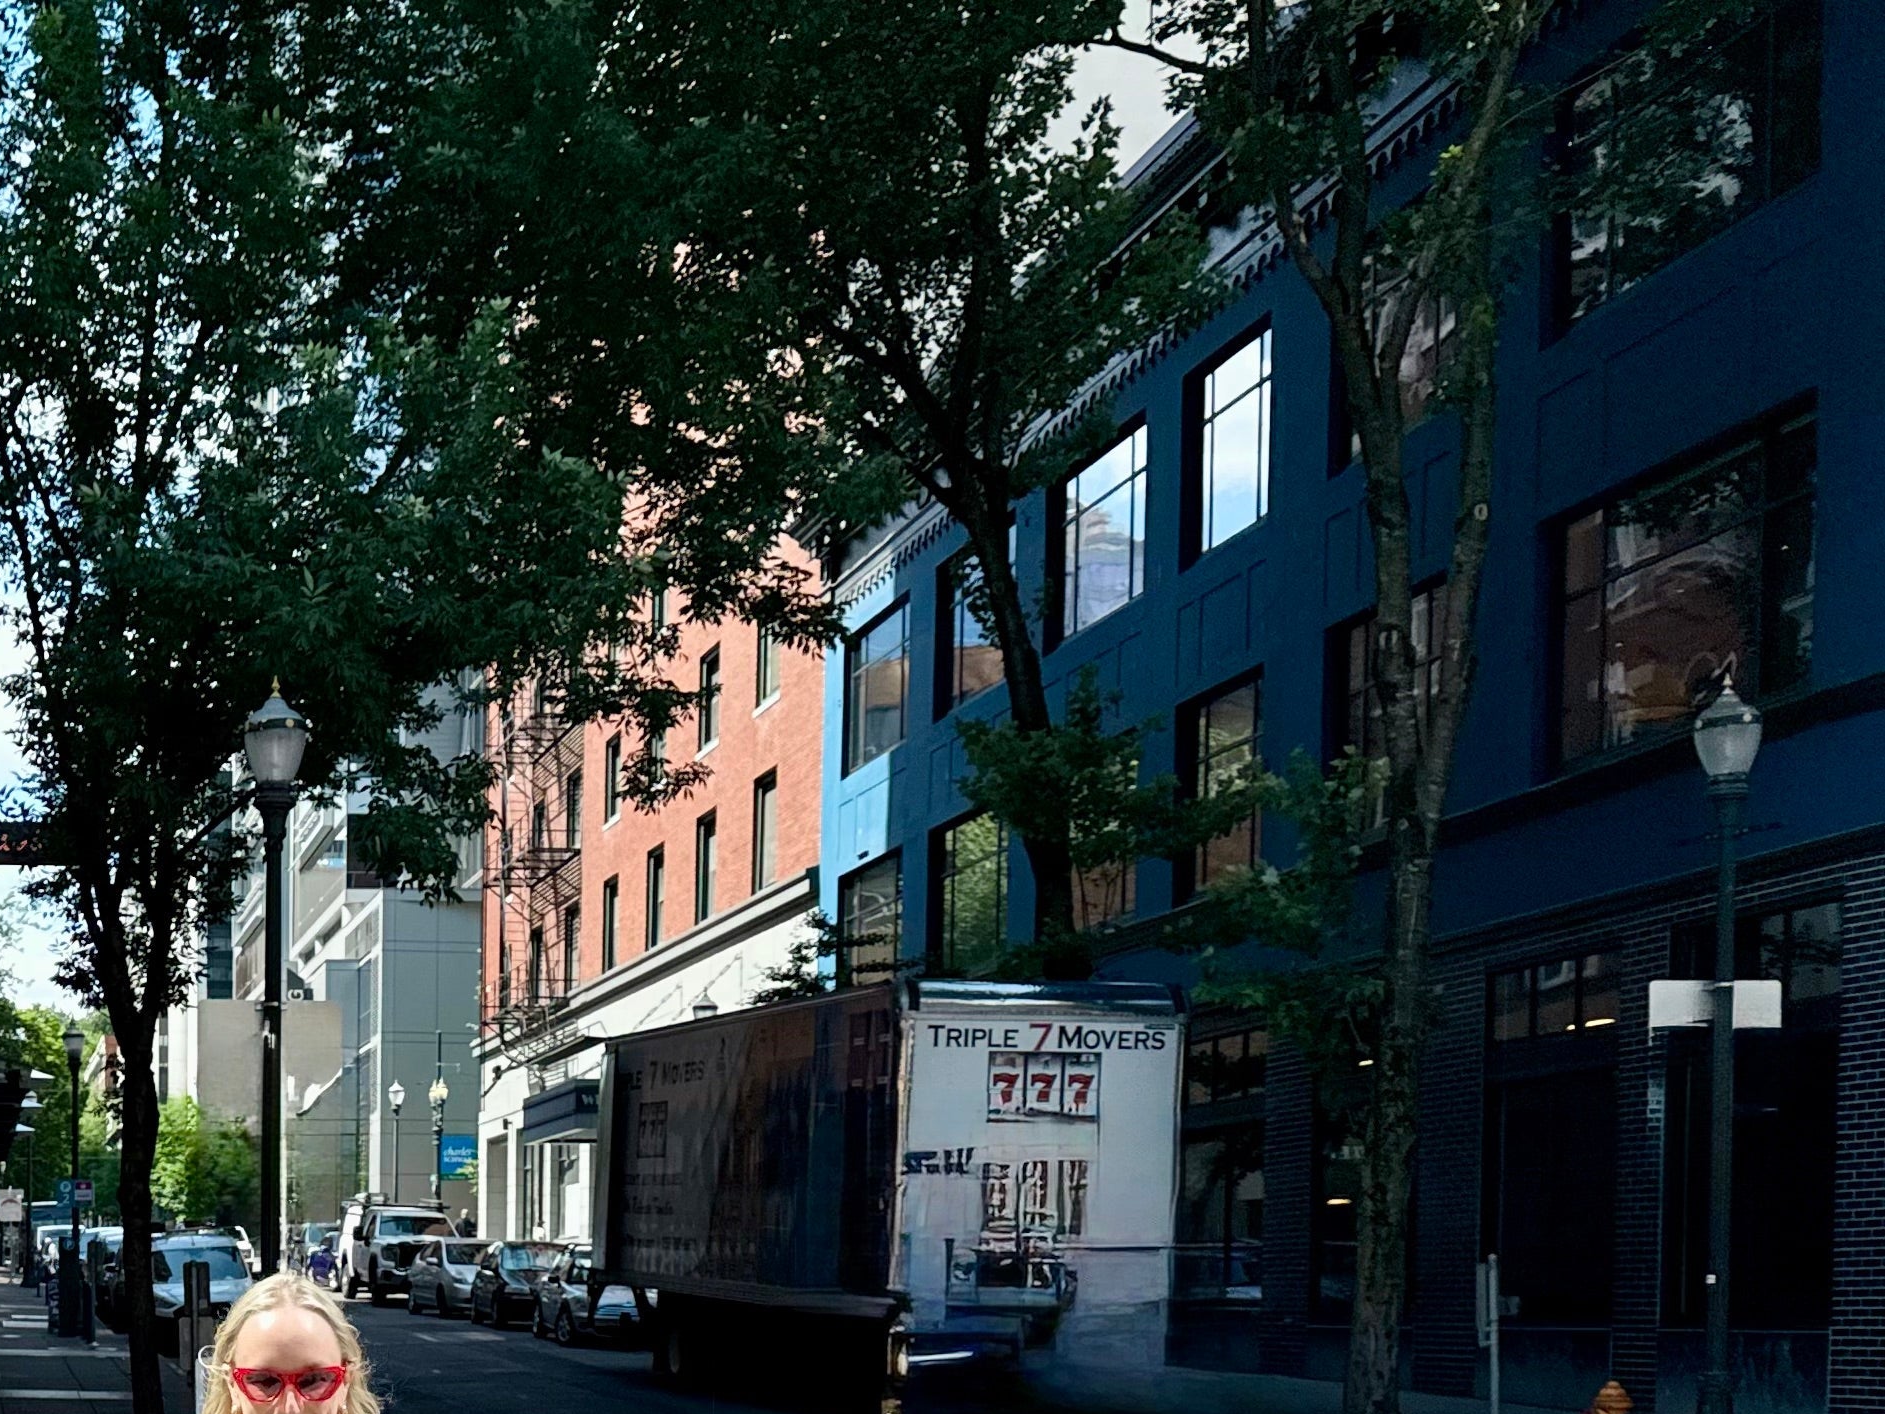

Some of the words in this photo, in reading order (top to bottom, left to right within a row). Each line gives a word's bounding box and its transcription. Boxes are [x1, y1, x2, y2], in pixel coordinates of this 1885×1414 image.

[927, 1024, 1019, 1049] TRIPLE
[1029, 1022, 1054, 1052] 7
[1057, 1025, 1166, 1050] MOVERS
